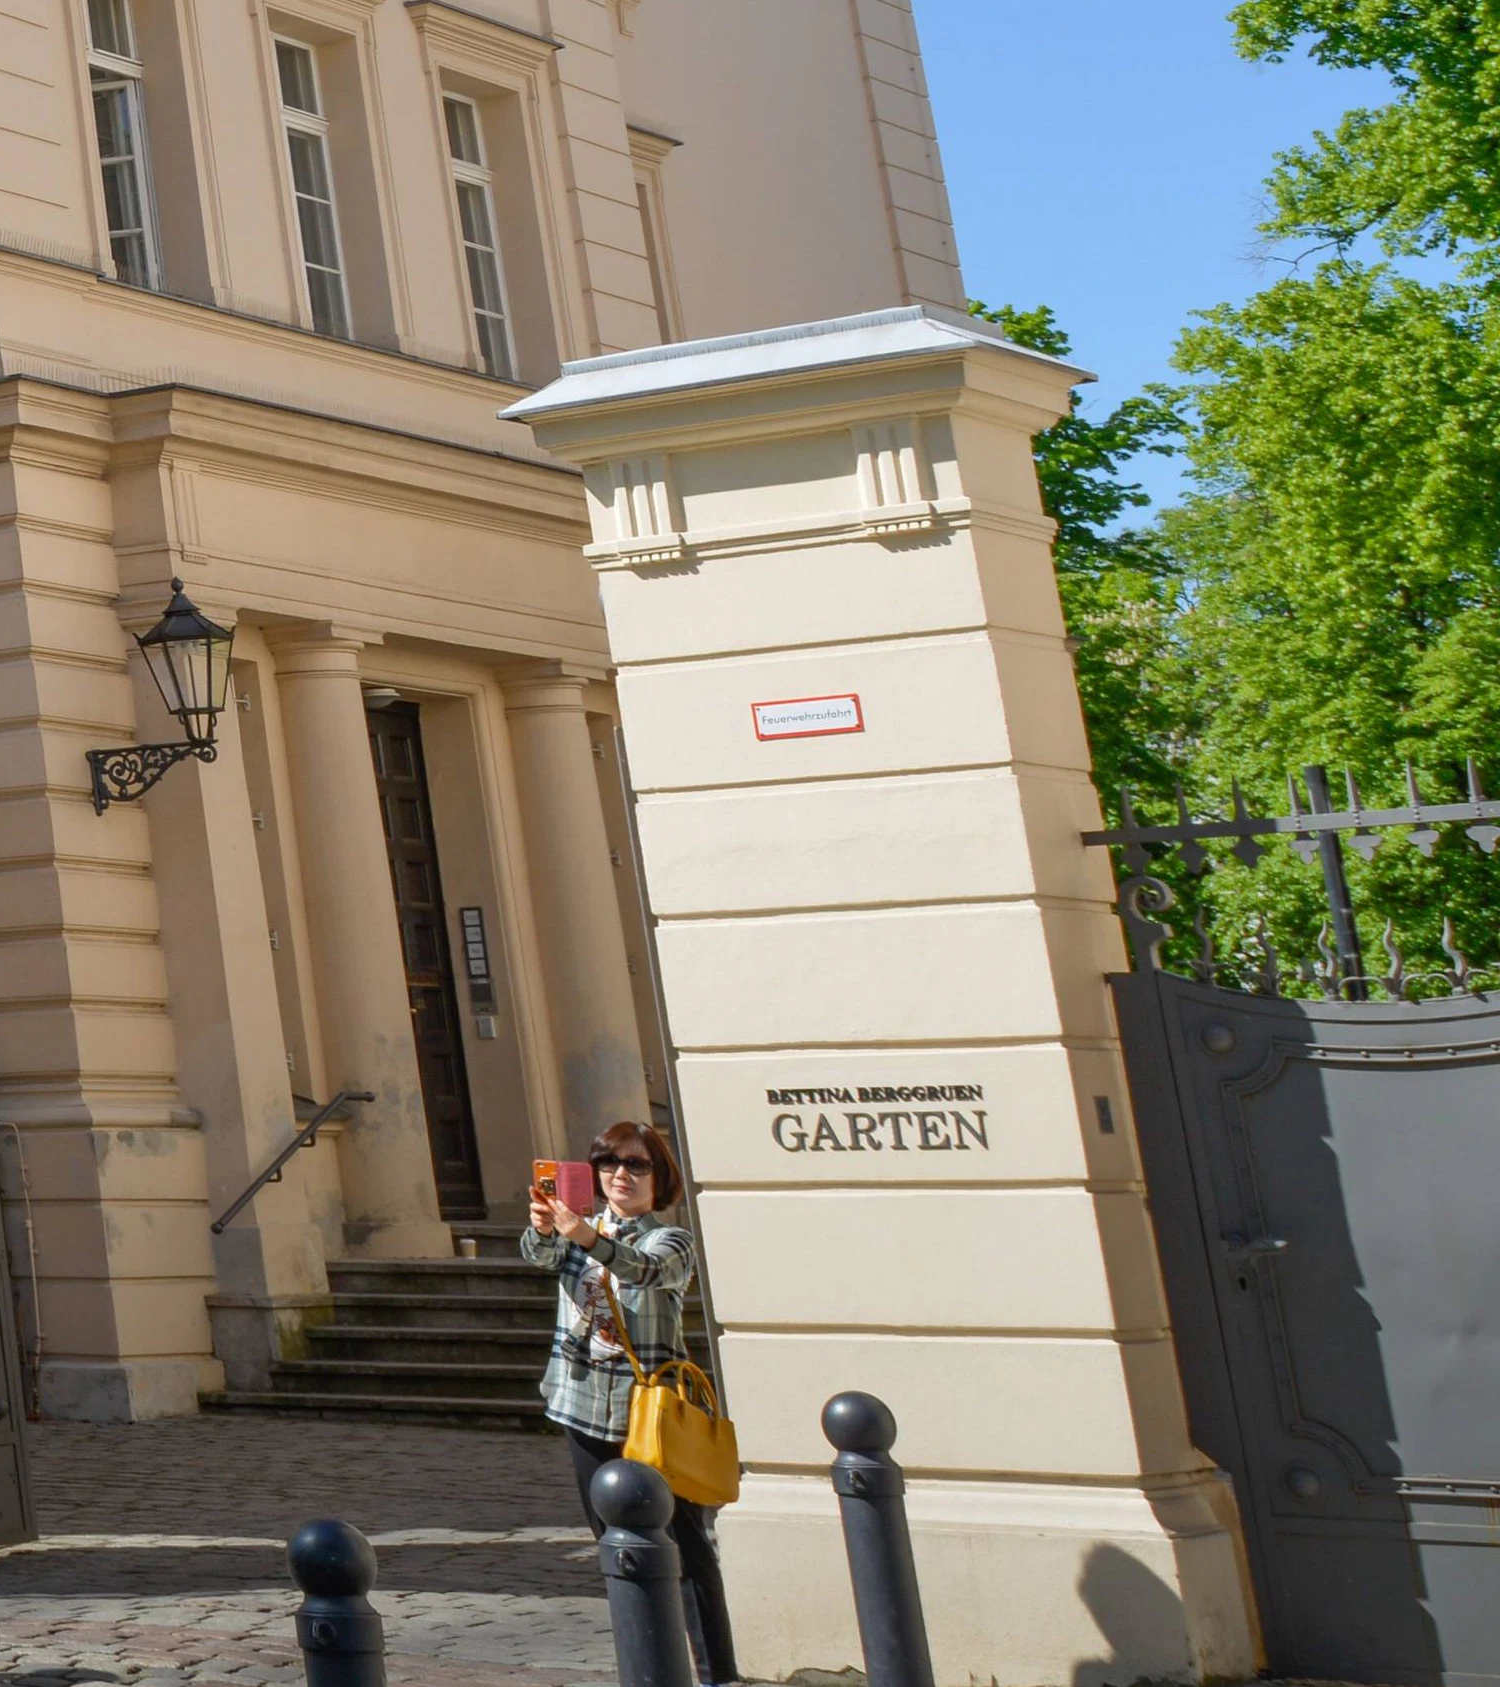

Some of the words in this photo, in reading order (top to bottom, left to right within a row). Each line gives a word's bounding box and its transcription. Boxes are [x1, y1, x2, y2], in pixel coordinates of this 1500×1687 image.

[762, 709, 852, 724] Feuerwehrzufahrt
[766, 1087, 856, 1105] BETTINA
[856, 1084, 984, 1103] BERGGRUEN
[771, 1110, 990, 1152] GARTEN
